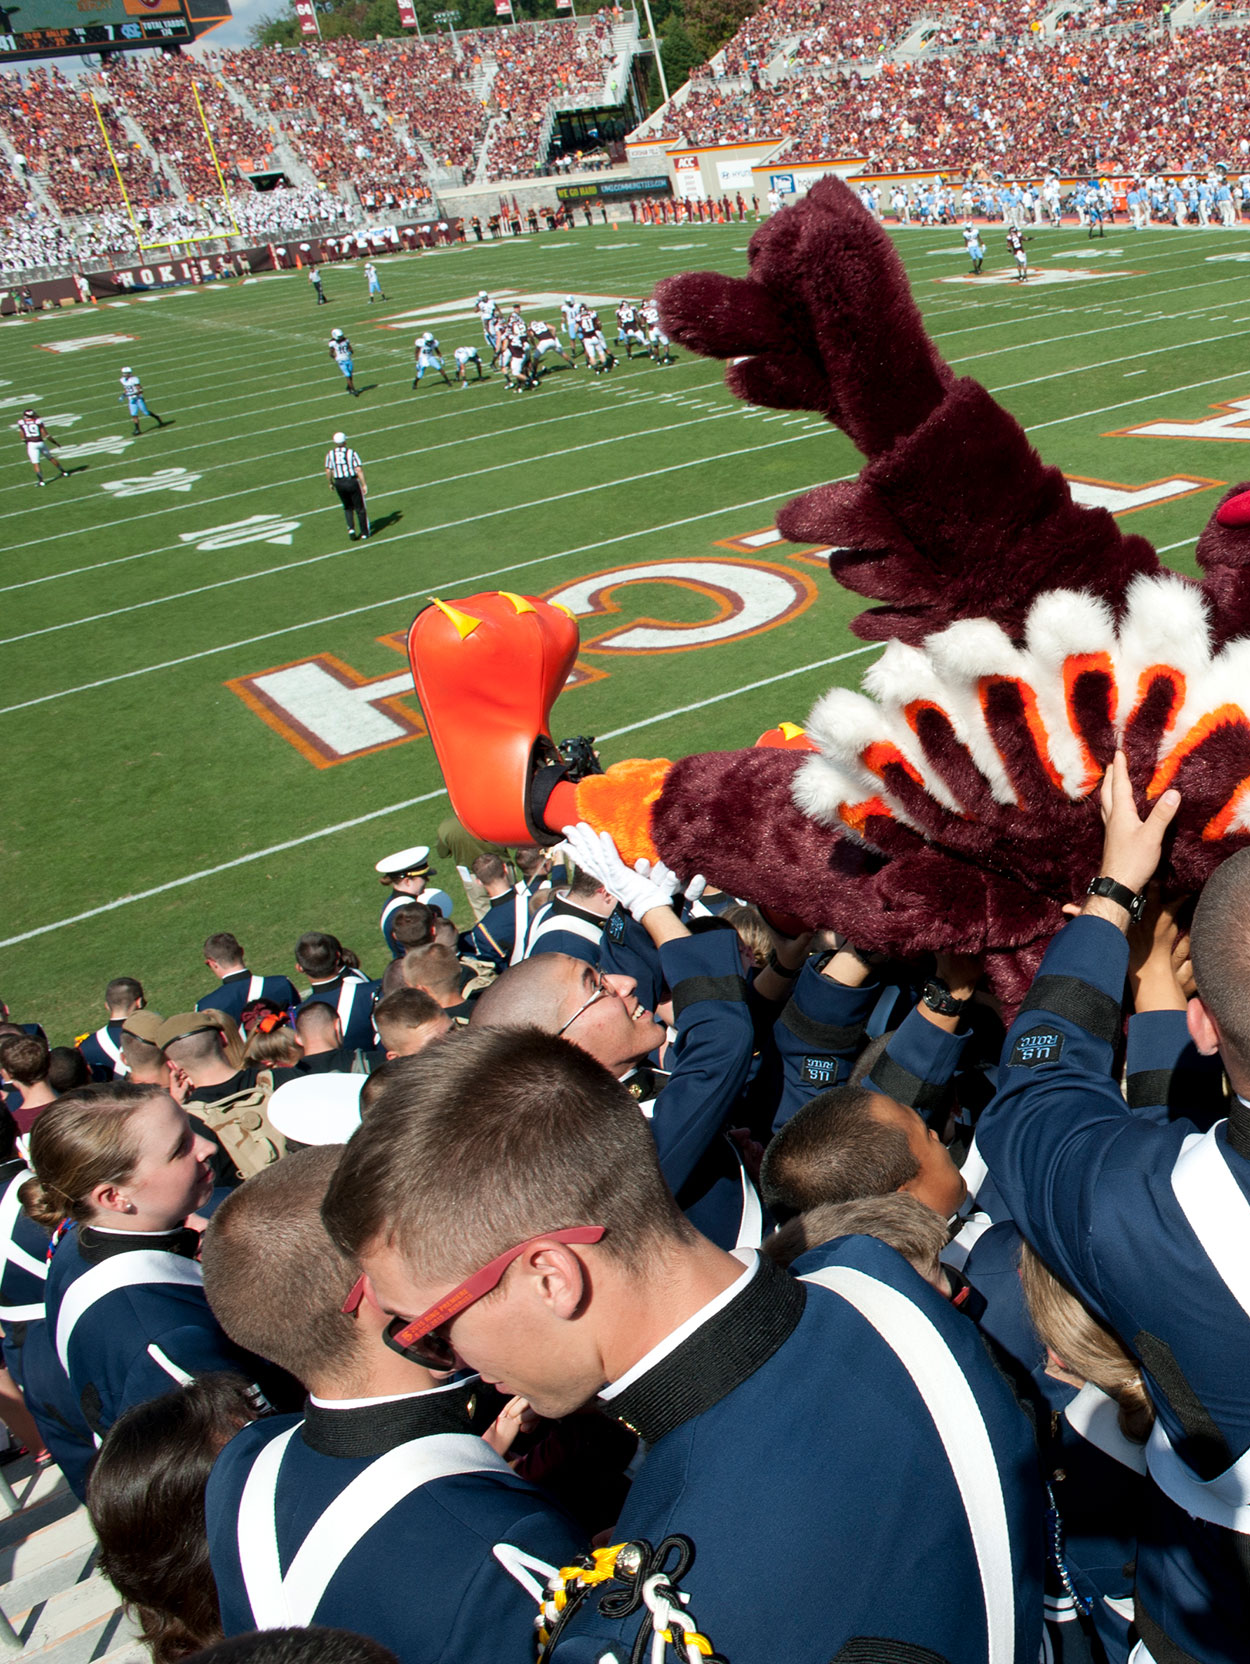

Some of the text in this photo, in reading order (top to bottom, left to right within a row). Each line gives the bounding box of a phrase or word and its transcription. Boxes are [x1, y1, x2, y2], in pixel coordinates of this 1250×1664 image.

[678, 157, 695, 169] ACC
[22, 424, 40, 437] 19
[335, 451, 347, 464] R
[178, 514, 302, 551] 10
